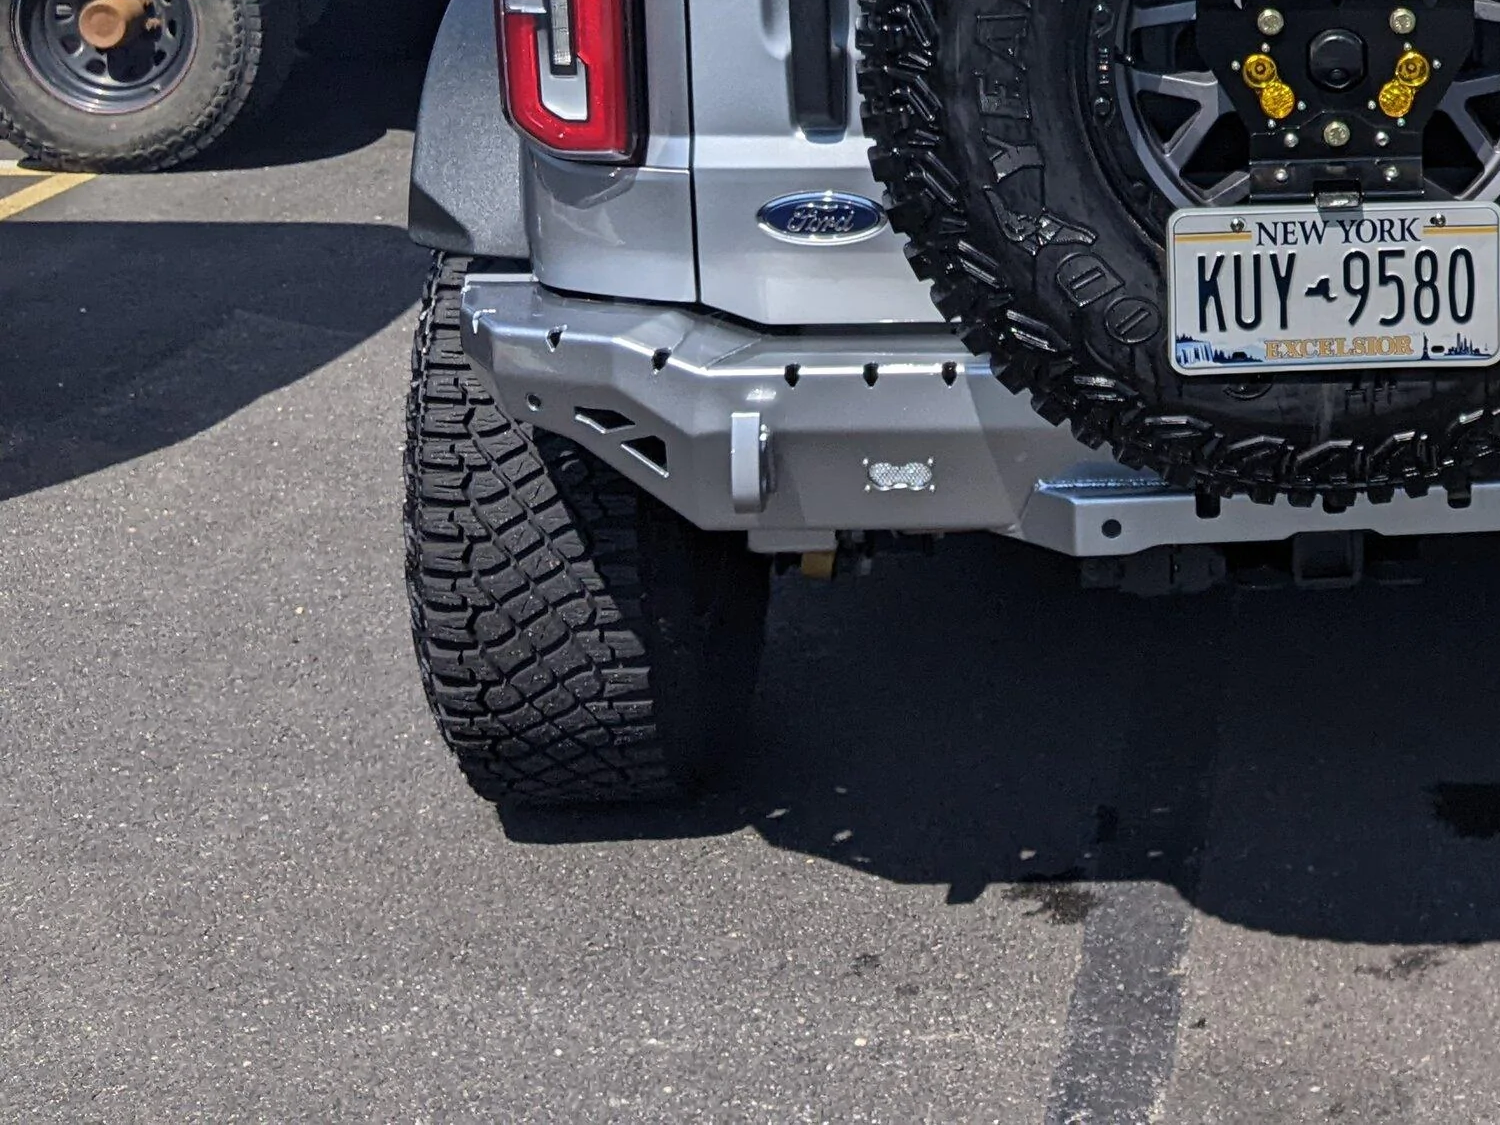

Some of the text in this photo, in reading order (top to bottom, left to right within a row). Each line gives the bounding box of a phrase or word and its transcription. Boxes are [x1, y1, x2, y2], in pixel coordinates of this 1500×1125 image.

[787, 204, 855, 232] Ford
[1256, 217, 1421, 246] NEW YORK
[1197, 247, 1475, 332] KUY 9580
[1264, 335, 1415, 360] EXCELSIOR
